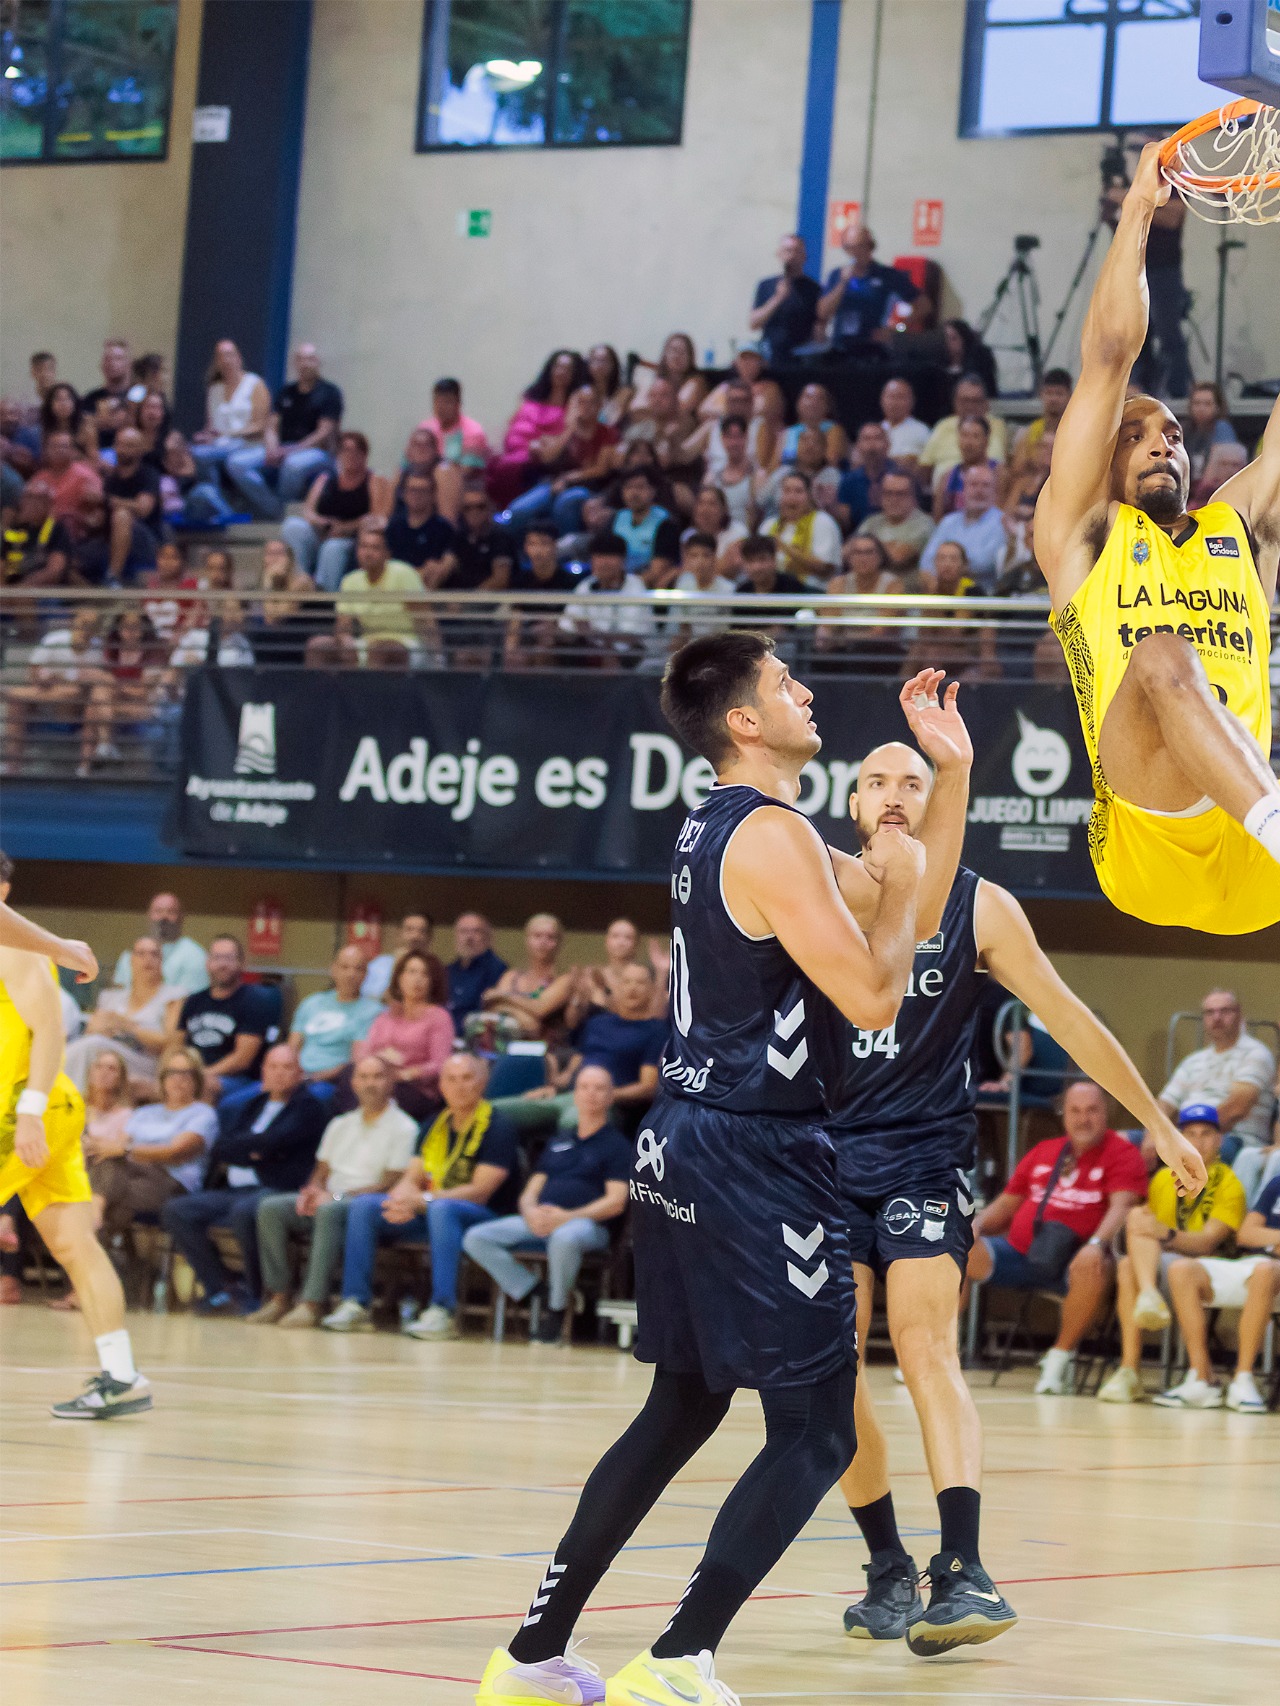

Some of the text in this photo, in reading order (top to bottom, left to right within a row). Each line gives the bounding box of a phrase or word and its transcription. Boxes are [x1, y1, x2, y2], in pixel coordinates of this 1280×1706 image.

[1117, 582, 1251, 619] LA LAGUNA
[1196, 647, 1247, 664] mociones
[338, 735, 520, 822] Adeje
[534, 755, 610, 810] es
[967, 796, 1094, 825] JUEGO LIMPI
